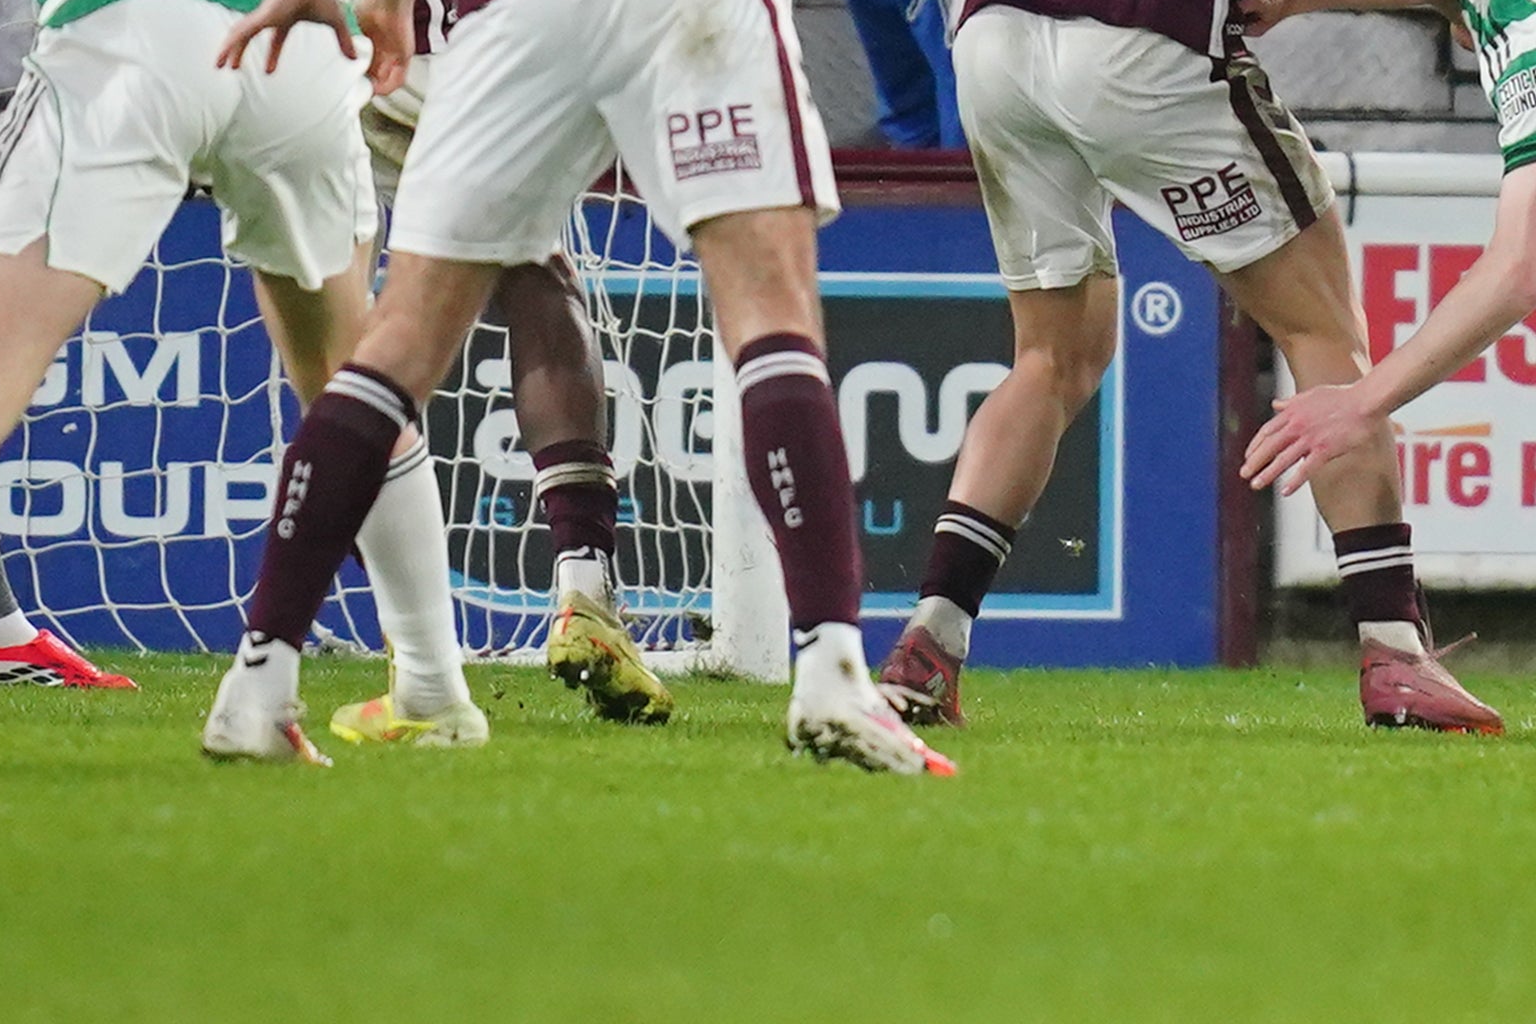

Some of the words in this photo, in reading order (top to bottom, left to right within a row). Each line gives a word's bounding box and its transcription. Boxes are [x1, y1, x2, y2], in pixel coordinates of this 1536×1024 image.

[667, 102, 755, 152] PPE
[1160, 161, 1251, 217] PPE
[1177, 189, 1254, 228] INDUSTRIAL
[1182, 216, 1239, 240] SUPPLIES
[1238, 203, 1260, 223] LTD
